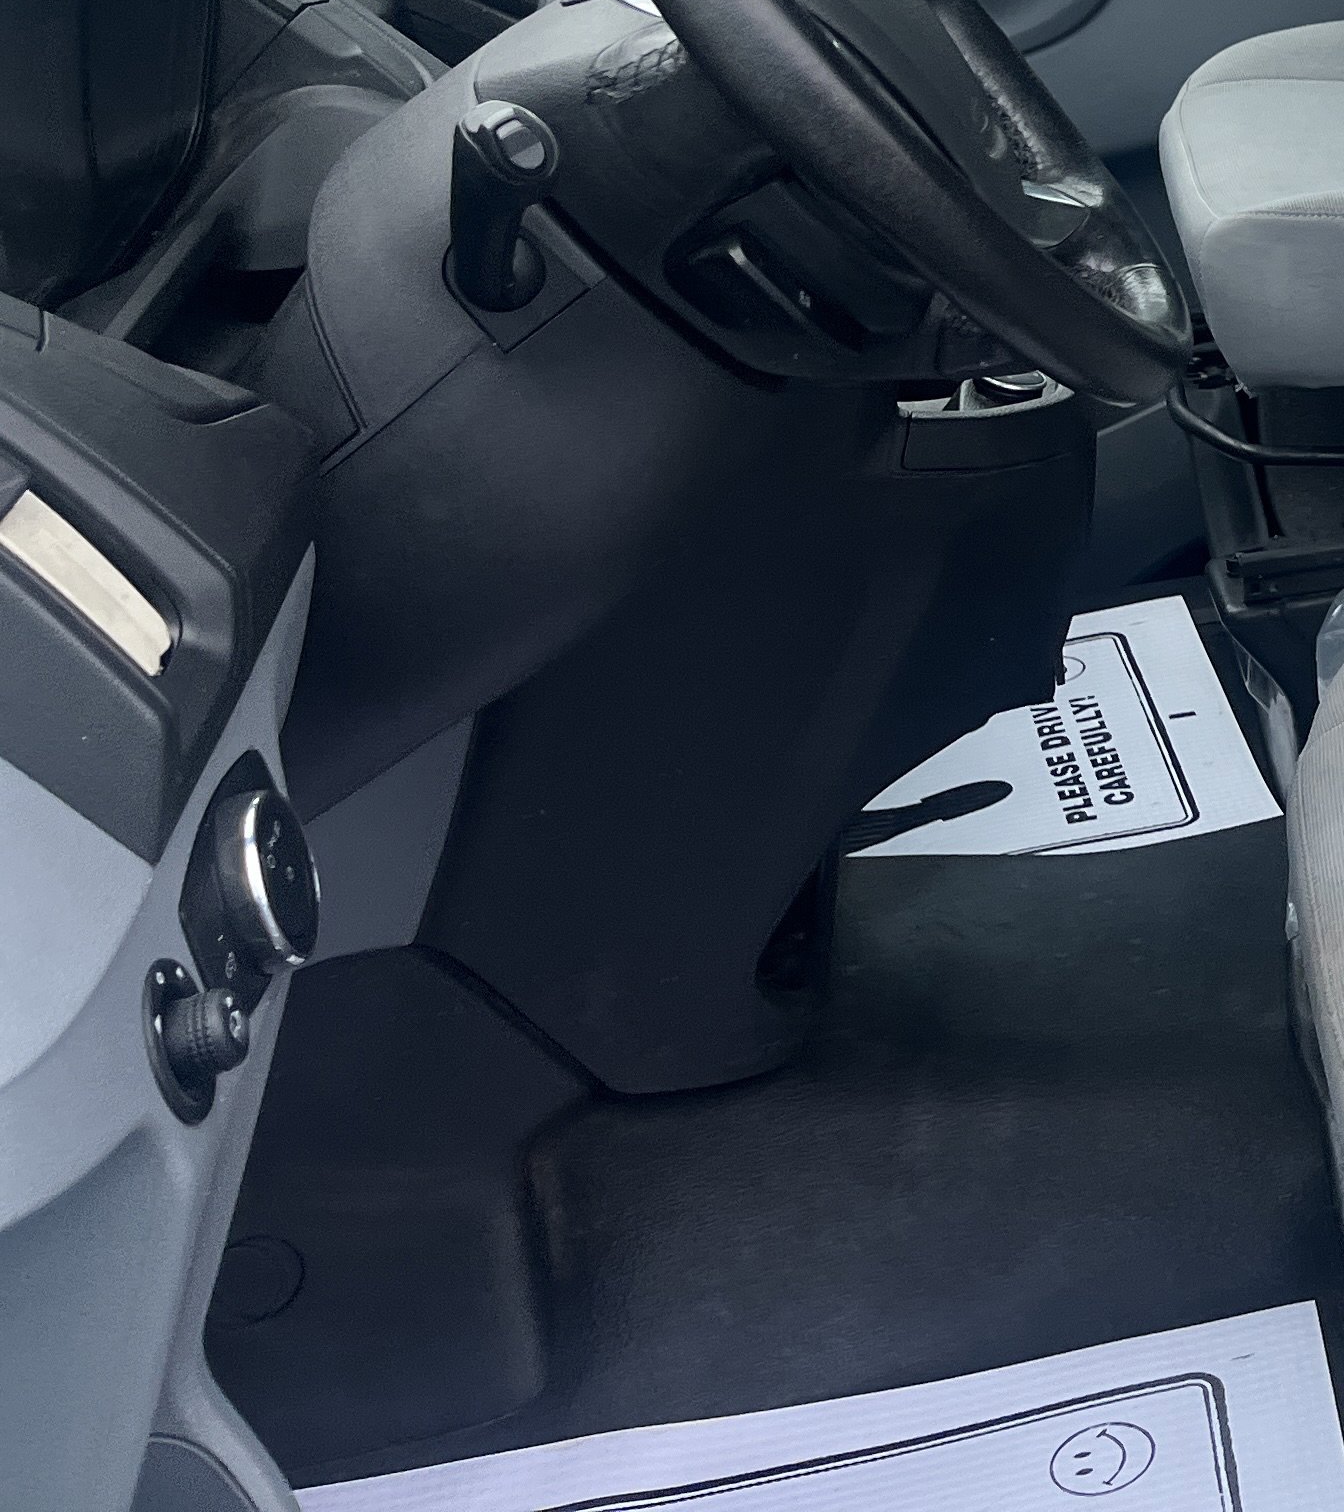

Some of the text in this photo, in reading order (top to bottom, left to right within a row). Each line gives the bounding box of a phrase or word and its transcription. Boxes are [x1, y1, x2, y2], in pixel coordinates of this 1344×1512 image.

[1029, 706, 1098, 825] PLEASE DRIV
[1068, 695, 1135, 806] CAREFULLY!
